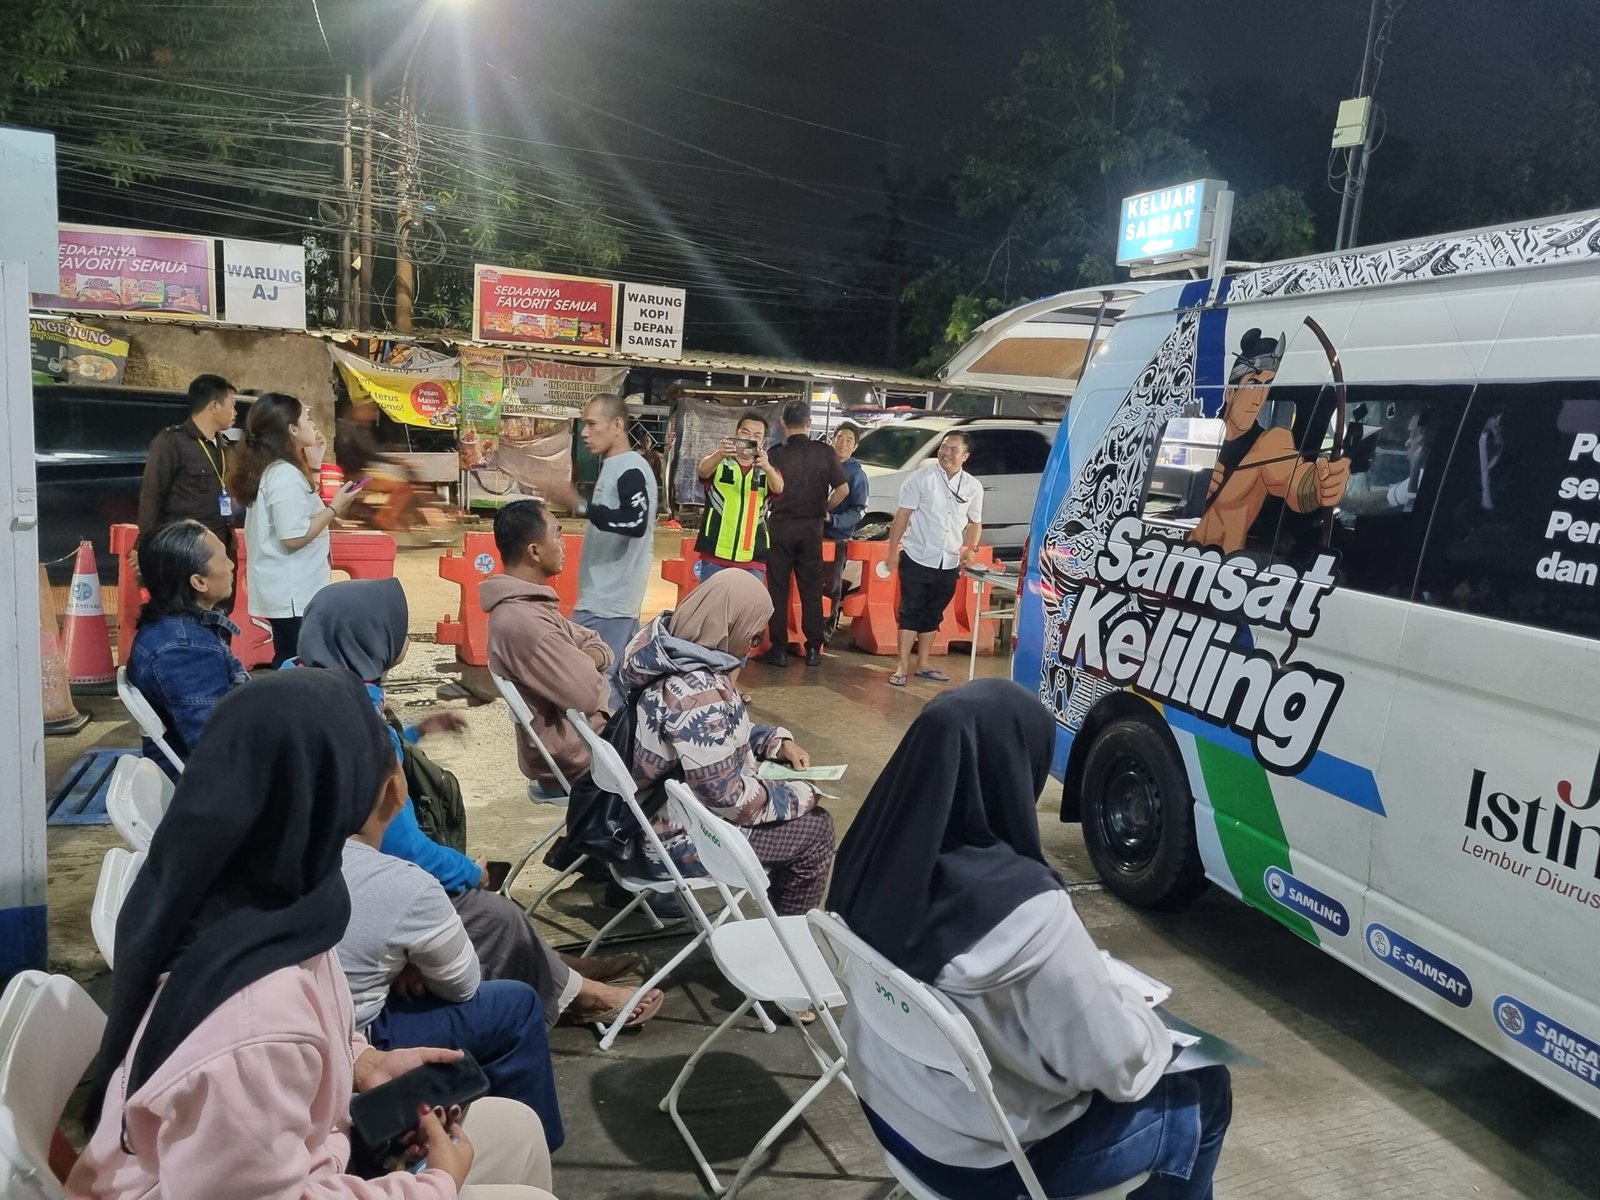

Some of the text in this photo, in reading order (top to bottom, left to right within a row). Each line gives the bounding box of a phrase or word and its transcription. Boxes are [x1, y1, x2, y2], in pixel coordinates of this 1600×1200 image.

[1128, 185, 1196, 219] KELUAR
[1125, 209, 1194, 241] SAMSAT
[129, 259, 188, 274] SEMUA
[226, 263, 303, 283] WARUNG
[252, 283, 279, 301] AJ
[494, 285, 560, 298] SEDAAPNYA
[627, 292, 682, 308] WARUNG
[496, 296, 597, 313] FAVORIT SEMUA
[639, 307, 669, 321] KOPI
[633, 321, 673, 335] DEPAN
[627, 335, 677, 349] SAMSAT
[548, 380, 583, 392] INDOMIE
[374, 390, 399, 402] terus
[417, 396, 440, 405] Maxim
[548, 391, 583, 401] INDOMIE
[380, 402, 404, 412] omo!
[1558, 477, 1600, 500] se
[1097, 516, 1335, 631] Samsat
[1535, 552, 1598, 586] dan
[1060, 585, 1338, 768] Keliling
[1461, 835, 1600, 908] Lembur Diurus
[1288, 886, 1342, 926] SAMLING
[1392, 945, 1467, 997] E-SAMSAT
[1535, 1020, 1600, 1068] SAMSA
